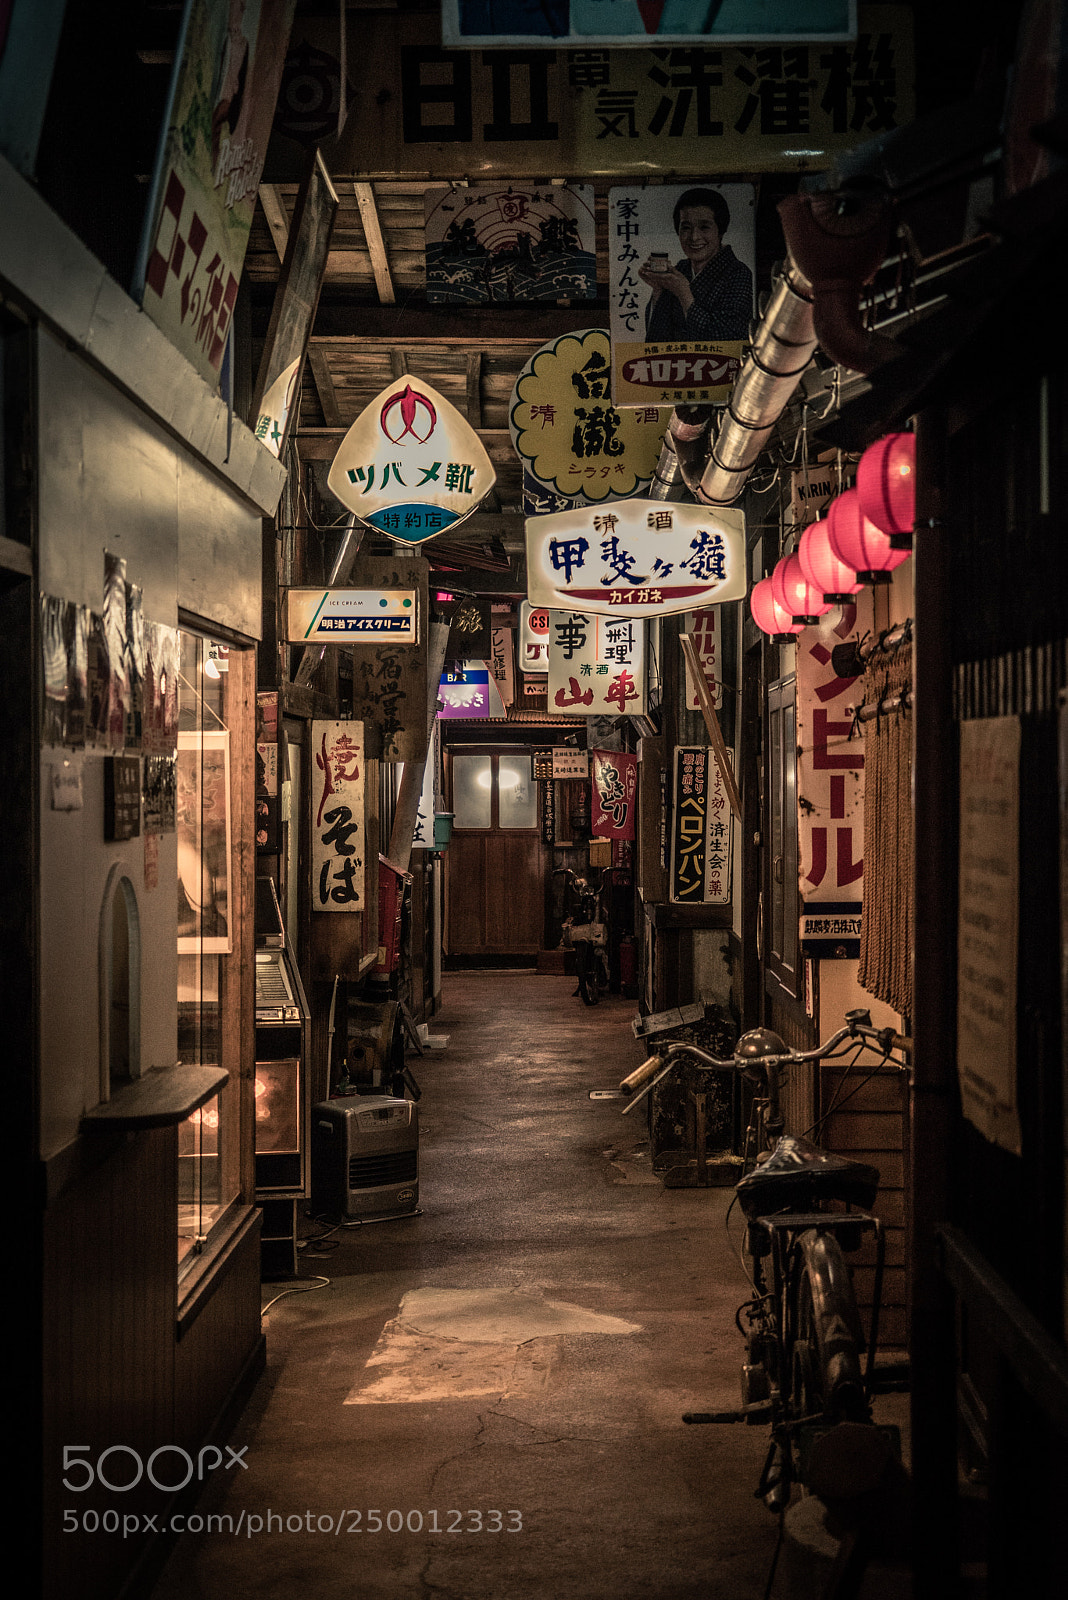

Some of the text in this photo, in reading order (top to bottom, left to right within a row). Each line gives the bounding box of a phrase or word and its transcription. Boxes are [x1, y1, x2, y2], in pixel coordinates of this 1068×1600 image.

[614, 196, 643, 333] 家中みんなで
[629, 359, 728, 382] オロナイン
[661, 391, 709, 400] 大塚製薬
[347, 461, 475, 494] ツバメ靴
[568, 462, 626, 479] シラタキ
[383, 511, 442, 528] 特約店
[610, 589, 663, 603] カイガネ
[554, 669, 640, 712] 山車
[694, 752, 706, 795] 肩のこり
[600, 763, 628, 829] やきとり
[678, 797, 705, 896] ペロンバン
